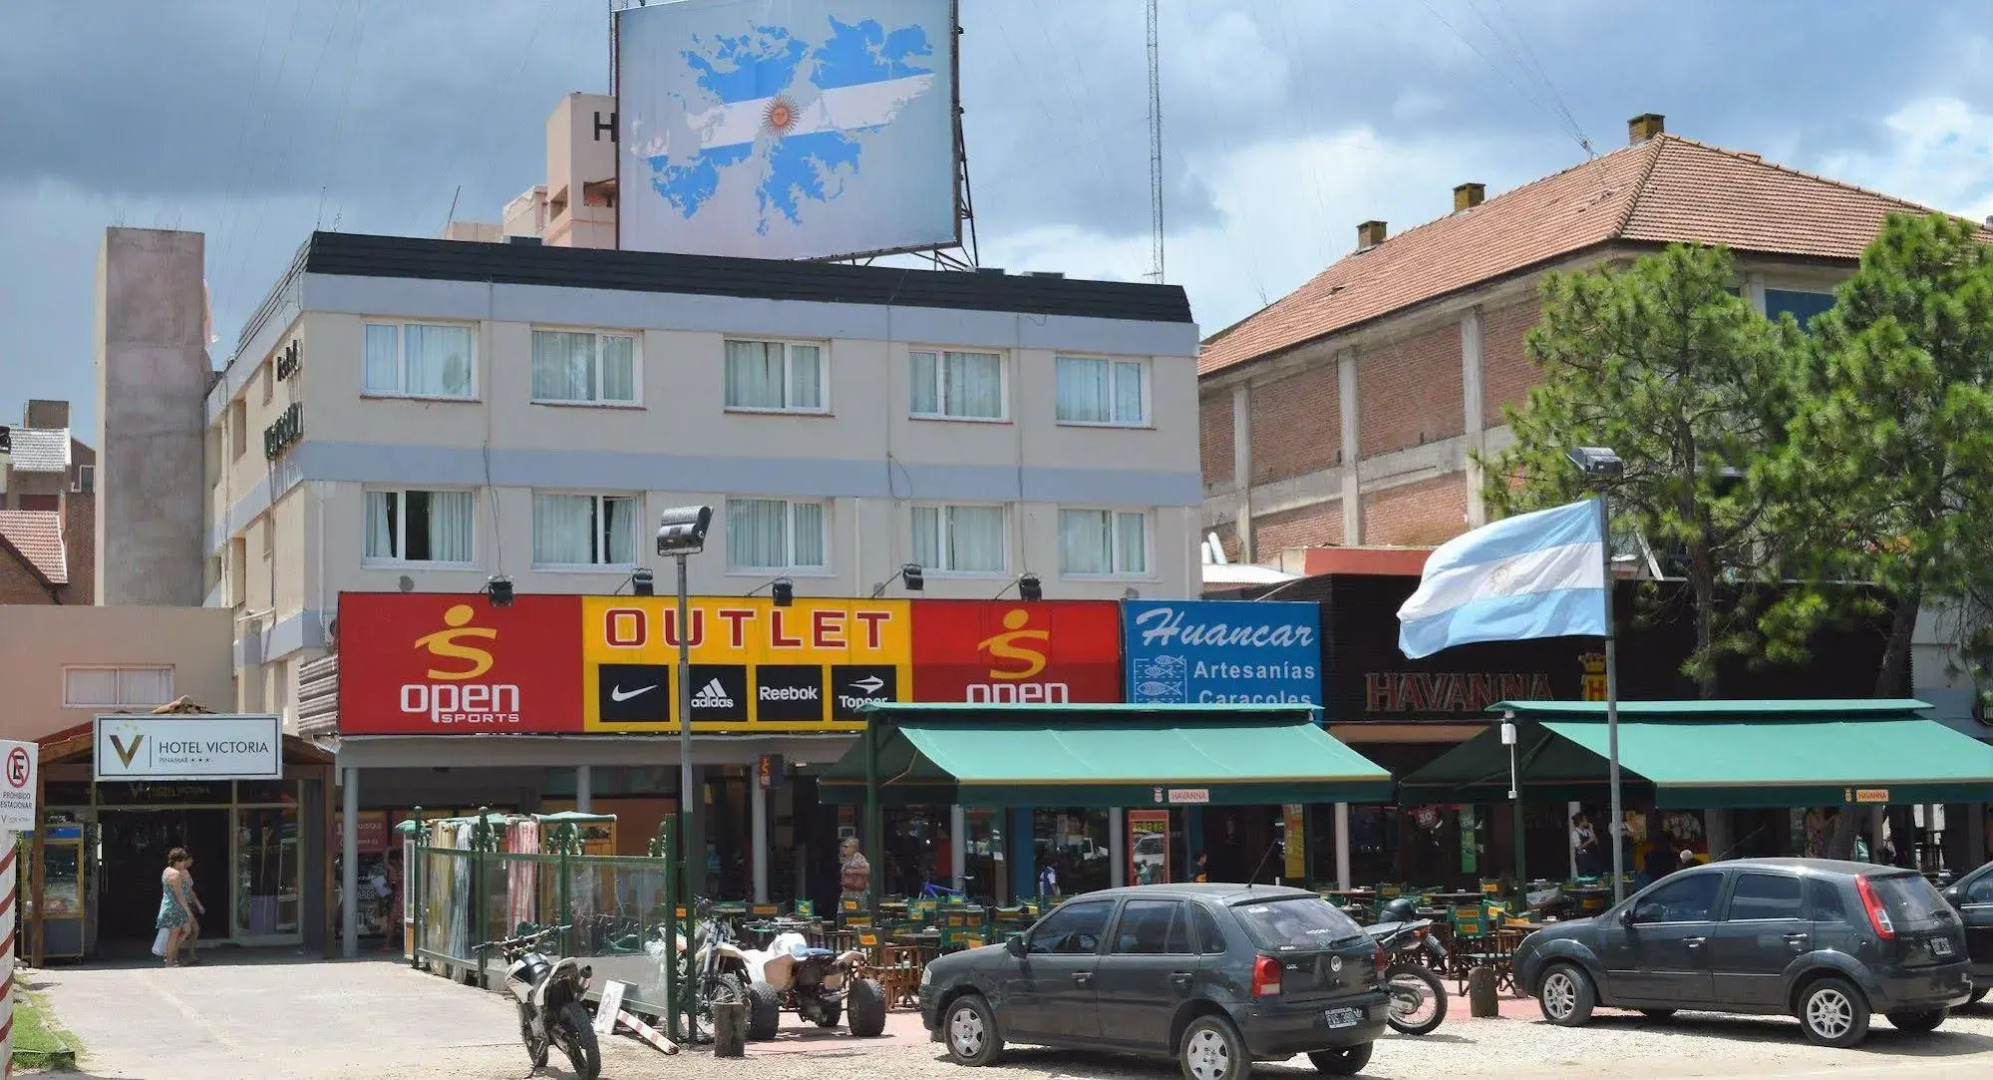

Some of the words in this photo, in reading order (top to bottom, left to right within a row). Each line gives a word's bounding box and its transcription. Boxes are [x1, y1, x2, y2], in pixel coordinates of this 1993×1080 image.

[605, 609, 891, 649] OUTLET
[1136, 607, 1315, 647] Huancar
[1194, 660, 1315, 680] Artesanías
[760, 685, 818, 701] Reebok
[1365, 672, 1553, 711] HAVANNA
[401, 683, 520, 722] open
[691, 696, 734, 708] adidas
[441, 713, 519, 722] SPORTS
[159, 742, 201, 753] HOTEL
[207, 741, 269, 753] VICTORIA
[3, 791, 31, 800] PROHIBIDO
